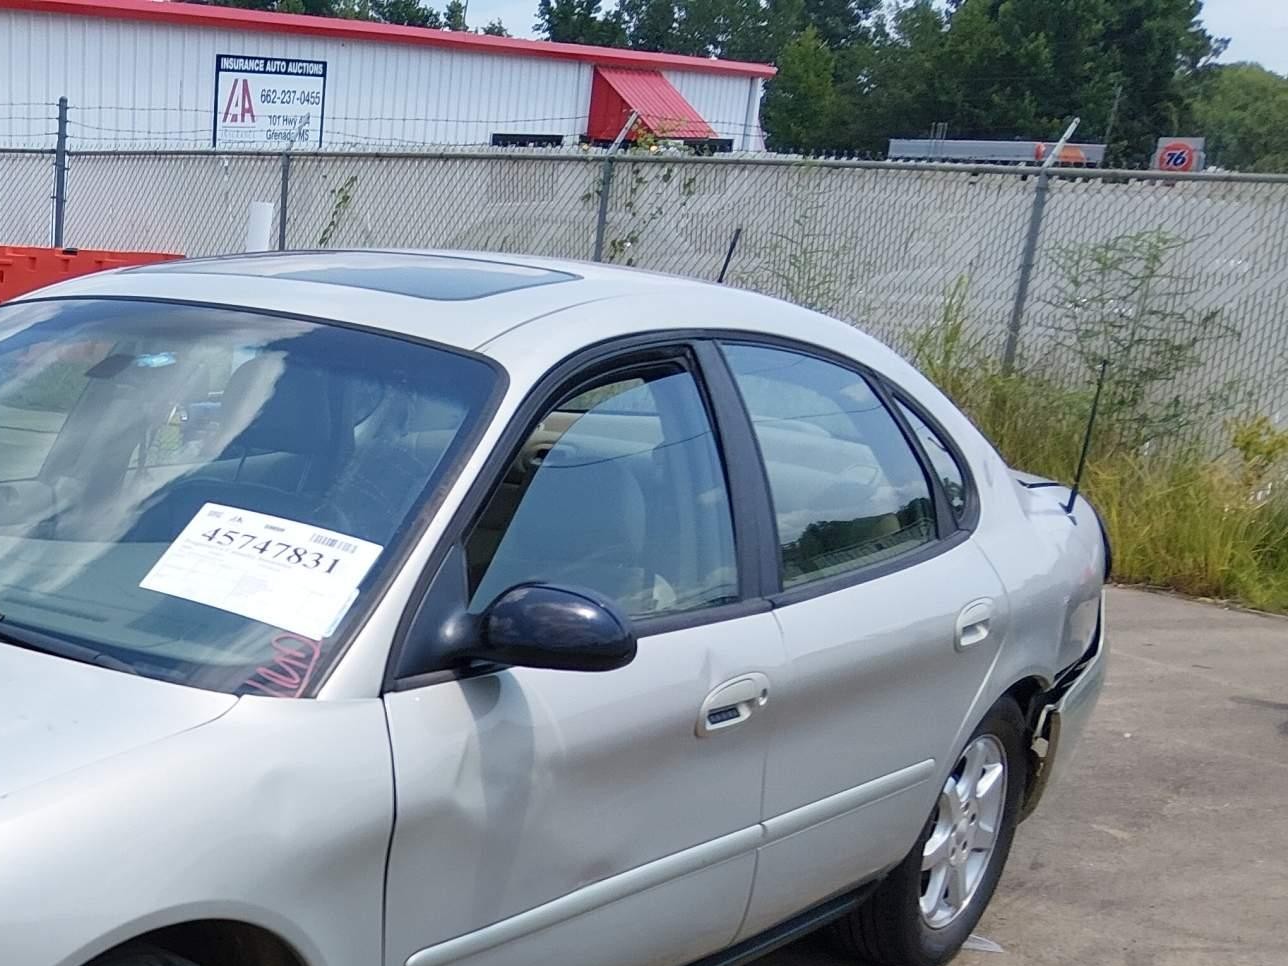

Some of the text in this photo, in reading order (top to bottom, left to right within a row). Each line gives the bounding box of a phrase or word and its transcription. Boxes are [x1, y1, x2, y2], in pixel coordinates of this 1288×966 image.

[221, 58, 323, 75] INSURANCE AUTO AUCTIONS
[261, 89, 320, 105] 662-237-0455
[282, 115, 297, 129] Hwy
[1166, 150, 1187, 167] 76
[201, 526, 341, 575] 45747831
